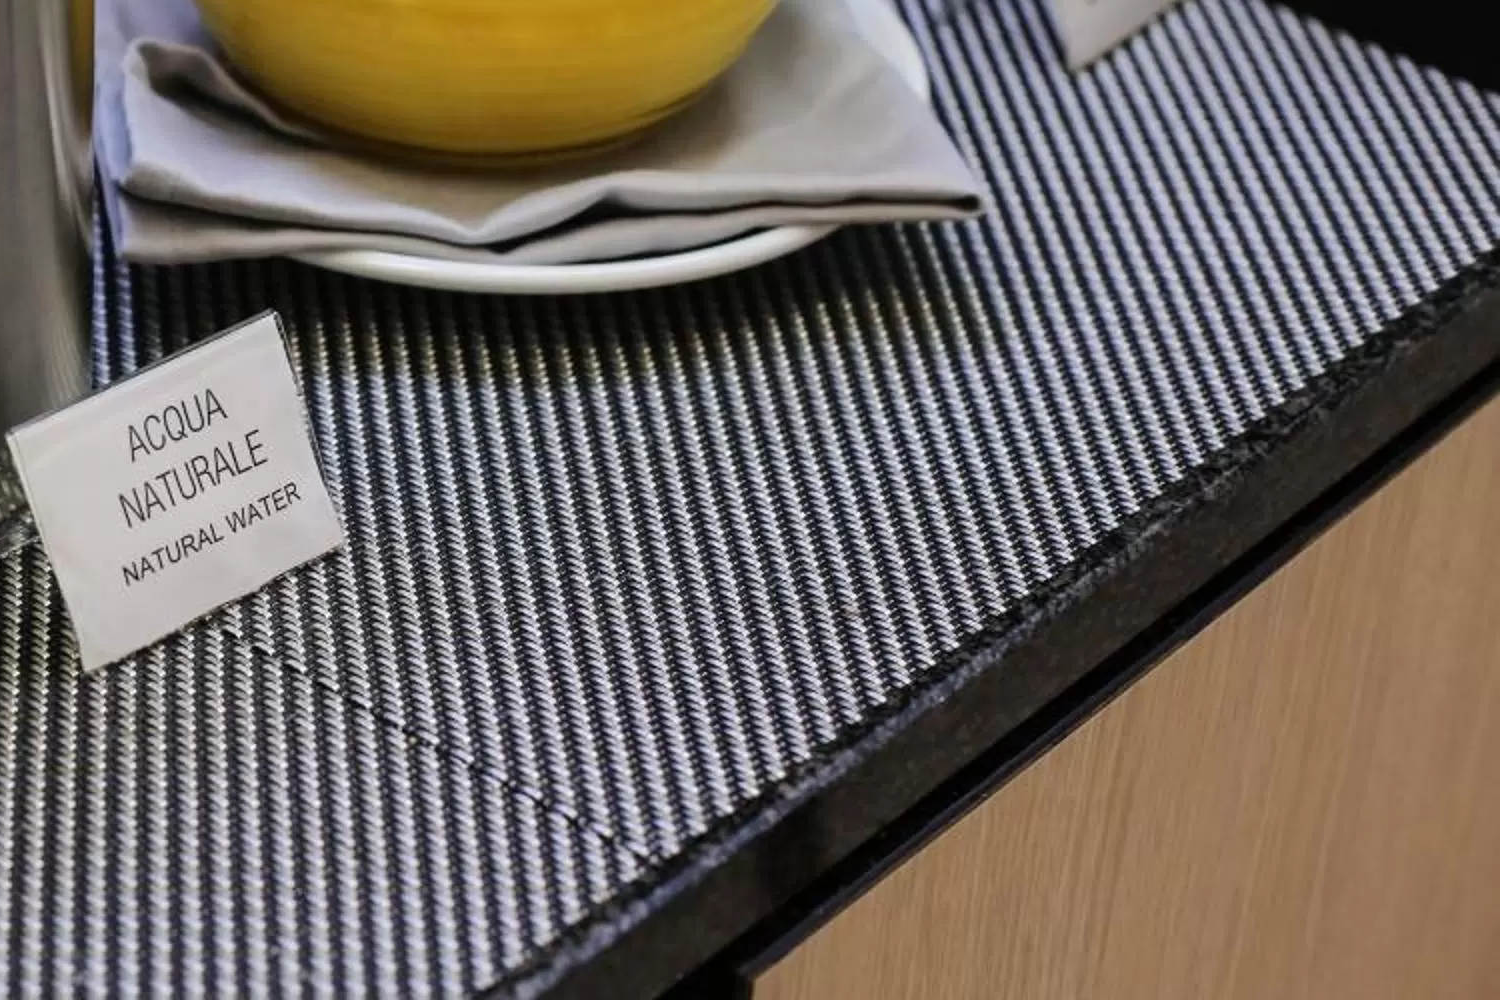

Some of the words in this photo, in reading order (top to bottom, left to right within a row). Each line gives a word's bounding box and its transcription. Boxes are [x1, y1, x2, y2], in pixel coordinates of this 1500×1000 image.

[128, 389, 228, 462] ACQUA
[118, 429, 268, 528] NATURALE
[122, 522, 224, 586] NATURAL
[225, 481, 301, 534] WATER
